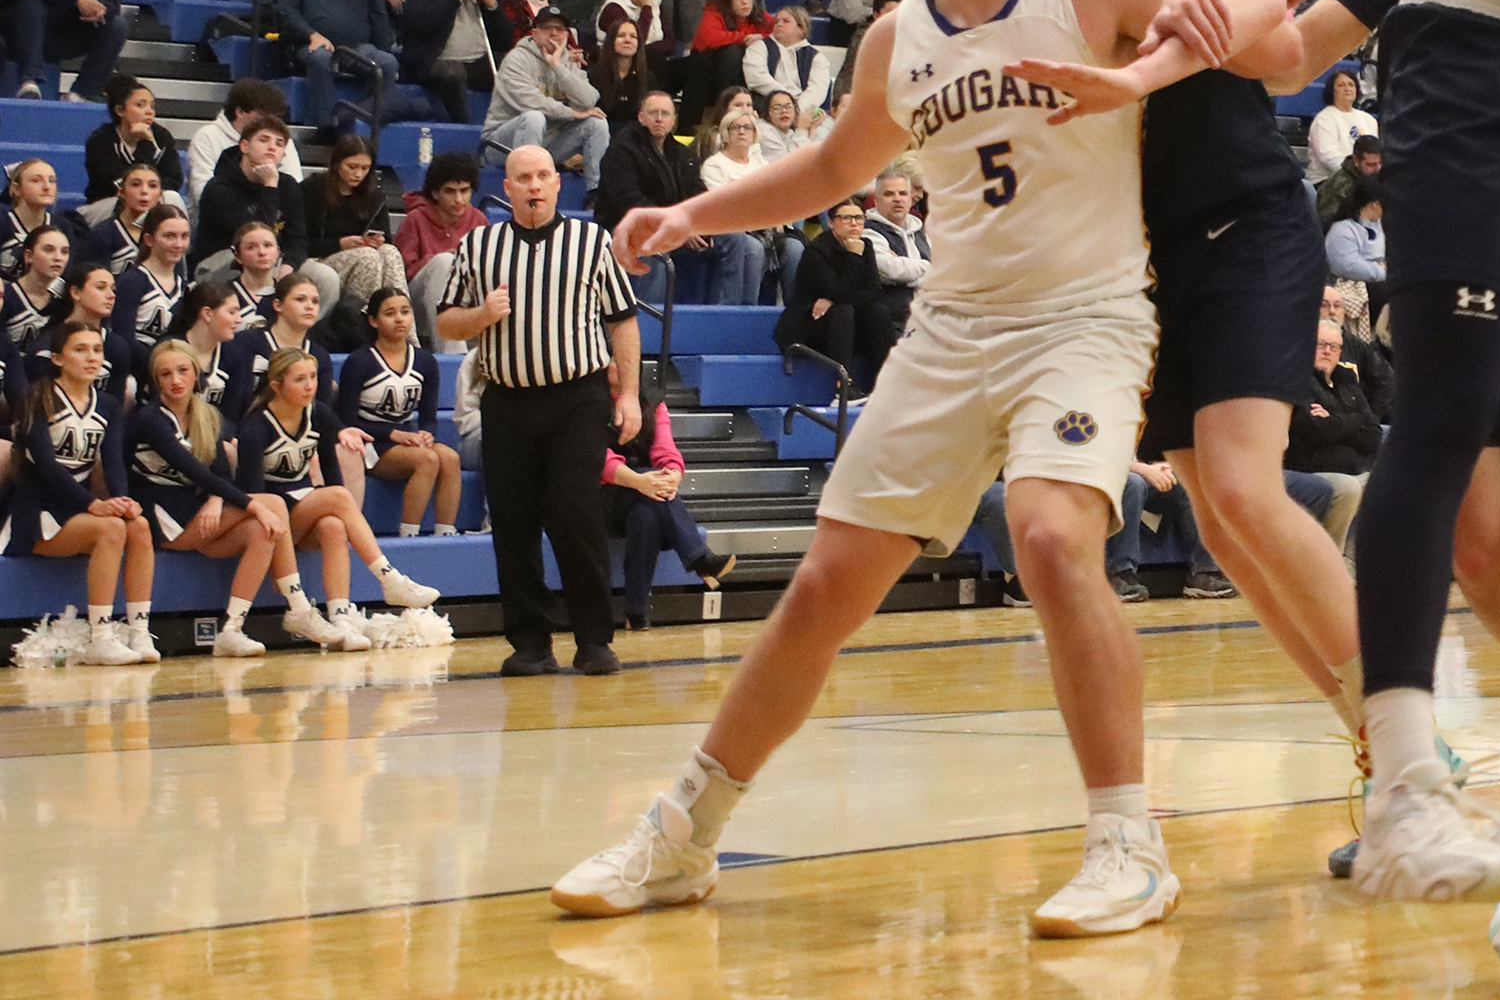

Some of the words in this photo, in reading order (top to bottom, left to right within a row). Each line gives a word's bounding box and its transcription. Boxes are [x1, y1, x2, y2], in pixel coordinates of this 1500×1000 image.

[908, 68, 1075, 149] COUGAR
[976, 141, 1018, 208] 5
[376, 385, 422, 415] AH
[55, 427, 105, 461] AH
